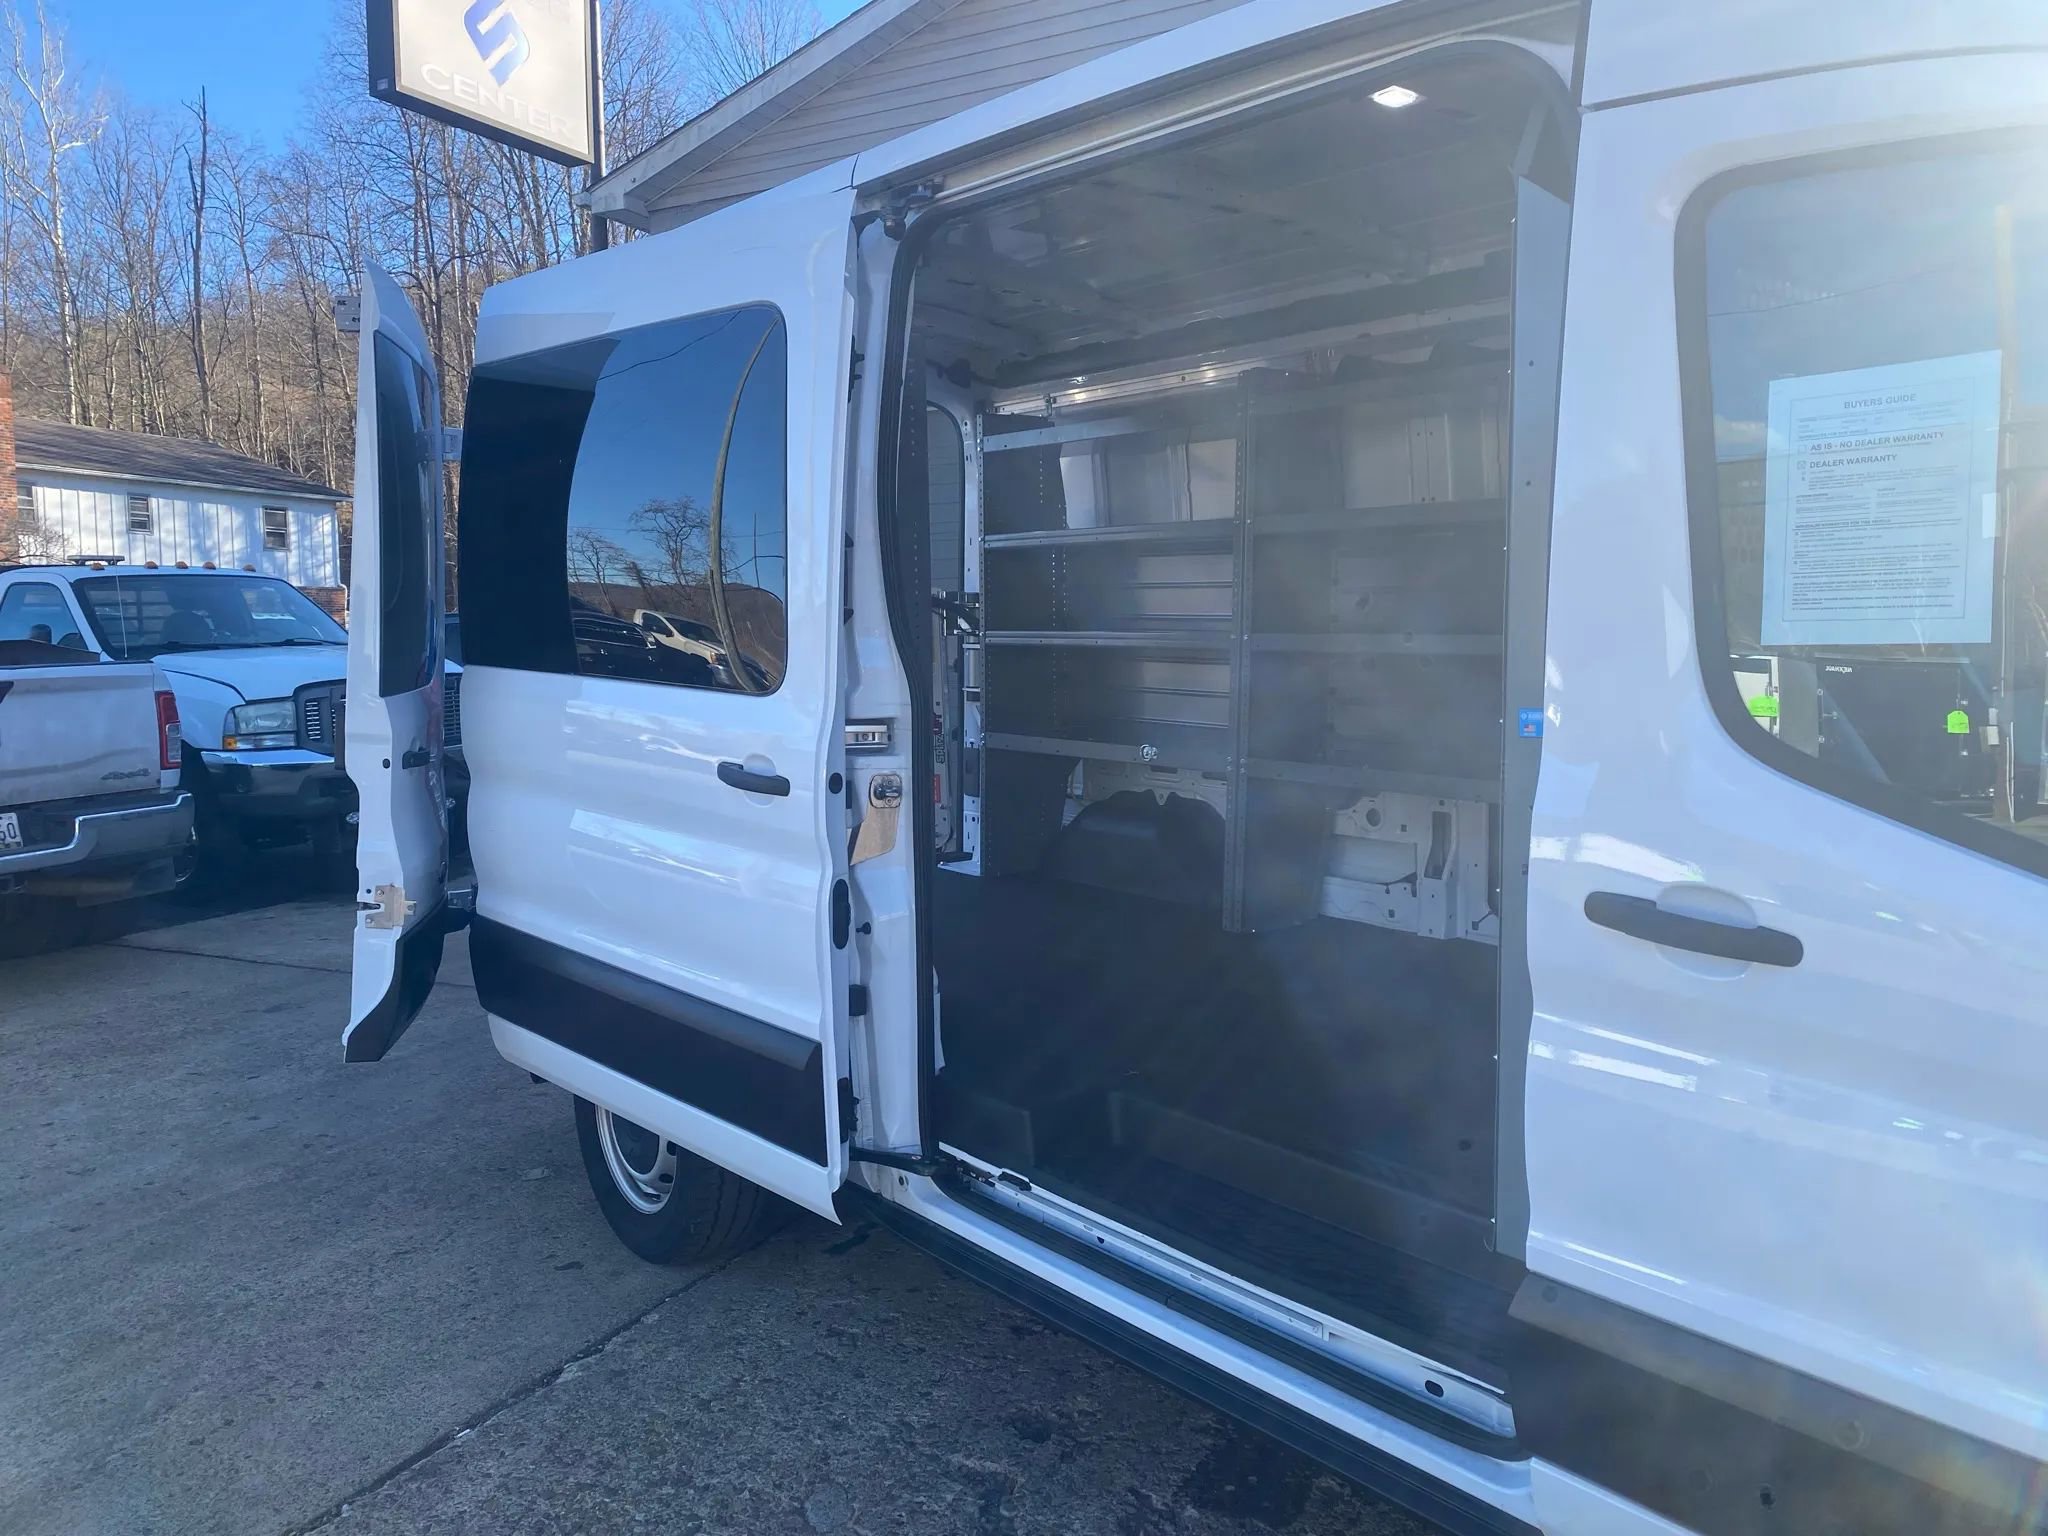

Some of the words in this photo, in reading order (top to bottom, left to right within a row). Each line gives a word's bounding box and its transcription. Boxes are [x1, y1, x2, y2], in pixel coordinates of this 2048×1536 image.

[420, 63, 570, 138] CENTER
[1843, 398, 1883, 409] BUYERS
[1885, 393, 1917, 404] GUIDE
[1810, 443, 1822, 451] AS
[1824, 442, 1832, 450] IS
[1839, 440, 1852, 449] NO
[1854, 436, 1891, 447] DEALER
[1892, 431, 1945, 444] WARRANTY
[1809, 459, 1845, 469] DEALER
[1846, 454, 1898, 466] WARRANTY
